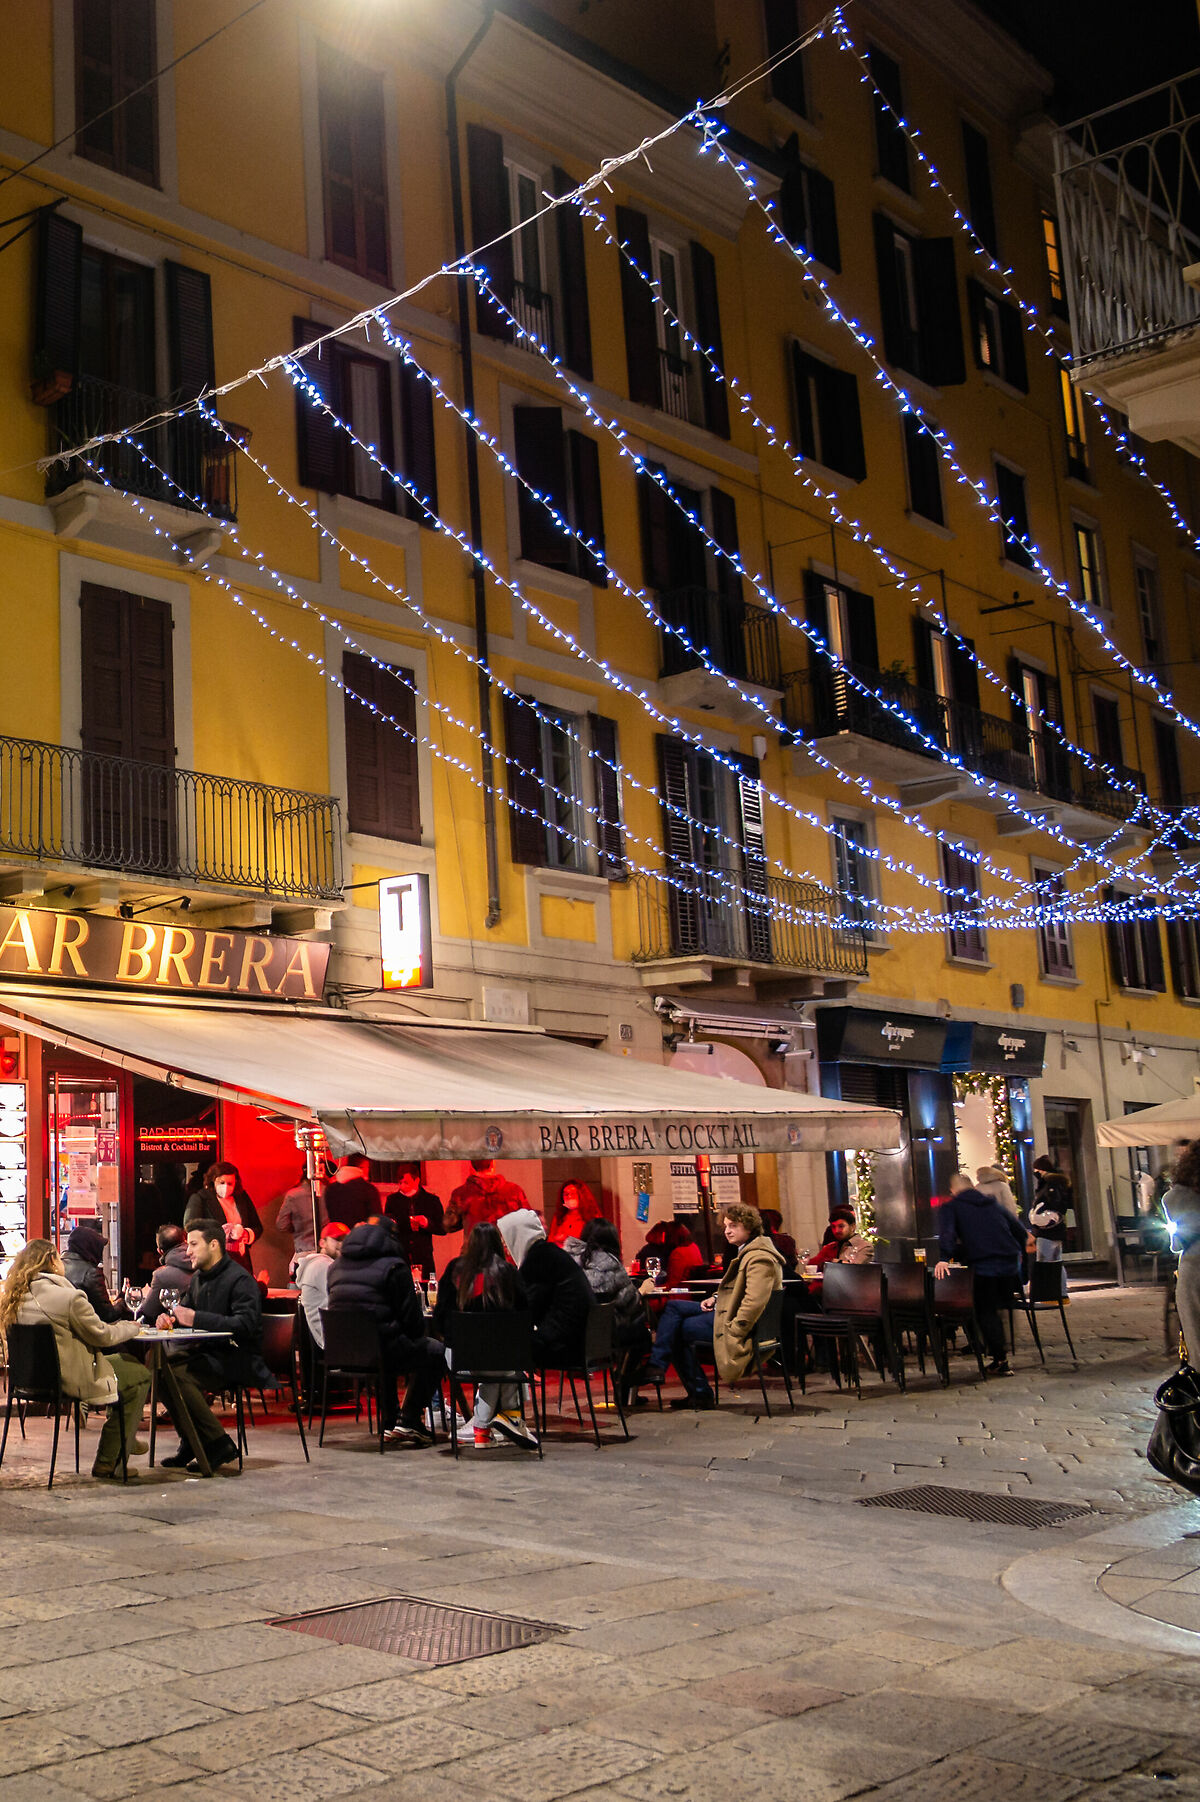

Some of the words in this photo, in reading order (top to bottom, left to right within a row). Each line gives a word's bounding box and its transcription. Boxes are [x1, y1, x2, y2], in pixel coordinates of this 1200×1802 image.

[387, 883, 412, 931] T
[116, 921, 320, 998] BRERA
[140, 1127, 164, 1141] BAR
[168, 1127, 210, 1141] BRERA
[539, 1125, 583, 1152] BAR
[588, 1124, 655, 1151] BRERA
[665, 1123, 760, 1150] COCKTAIL
[140, 1143, 162, 1151] Bistrot
[163, 1143, 170, 1151] &
[171, 1142, 197, 1151] Cocktail
[198, 1143, 210, 1151] Bar
[671, 1164, 696, 1174] FFITTA
[712, 1164, 738, 1174] AFFITTA
